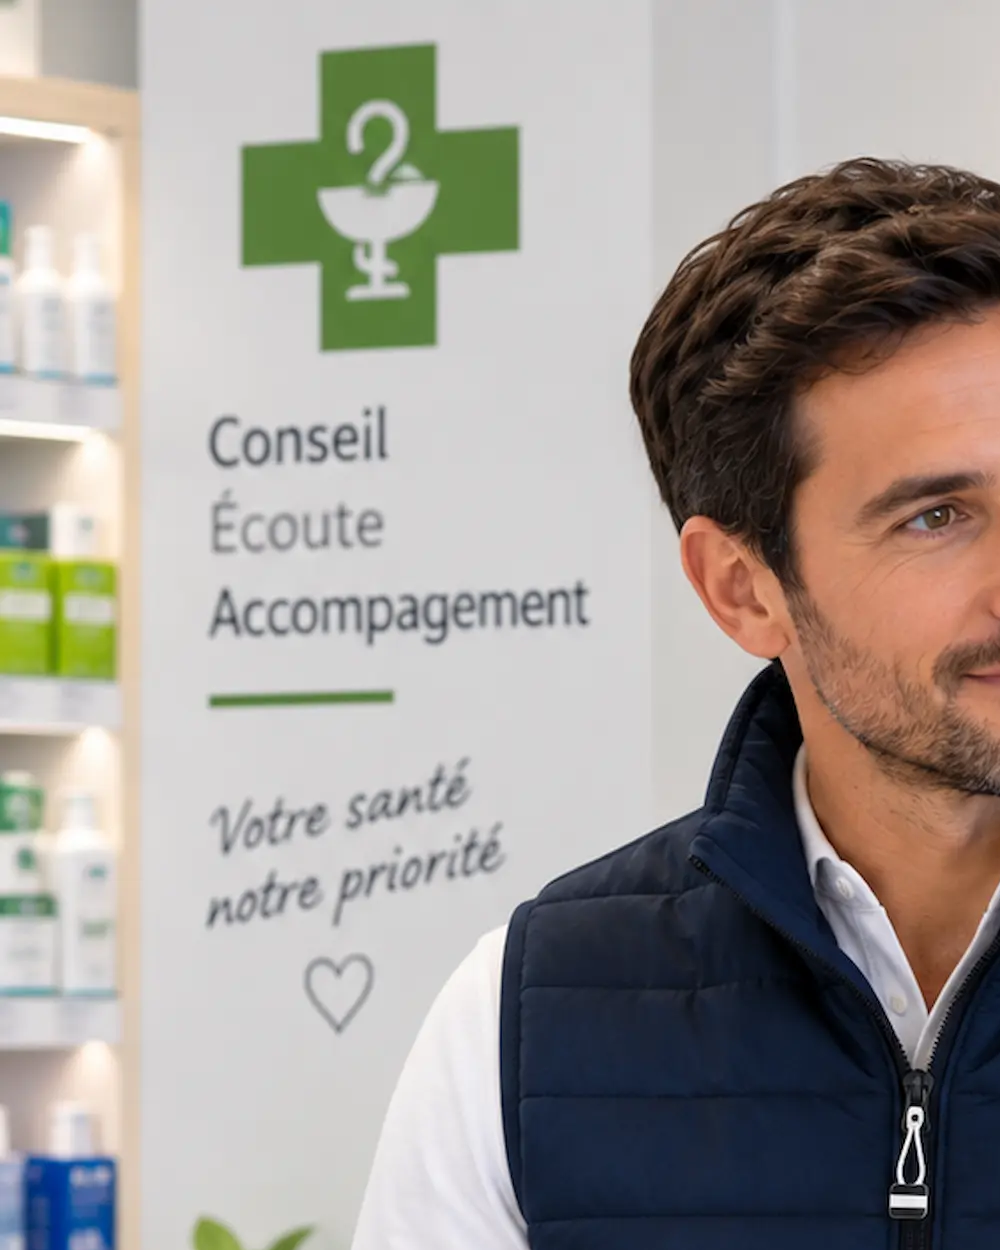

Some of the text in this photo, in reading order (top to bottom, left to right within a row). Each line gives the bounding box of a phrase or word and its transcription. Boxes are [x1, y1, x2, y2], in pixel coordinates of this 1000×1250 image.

[208, 405, 389, 467] Conseil
[211, 489, 385, 554] Écoute
[208, 579, 591, 647] Accompagement
[209, 756, 472, 857] Votre santé
[205, 822, 505, 929] notre priorité
